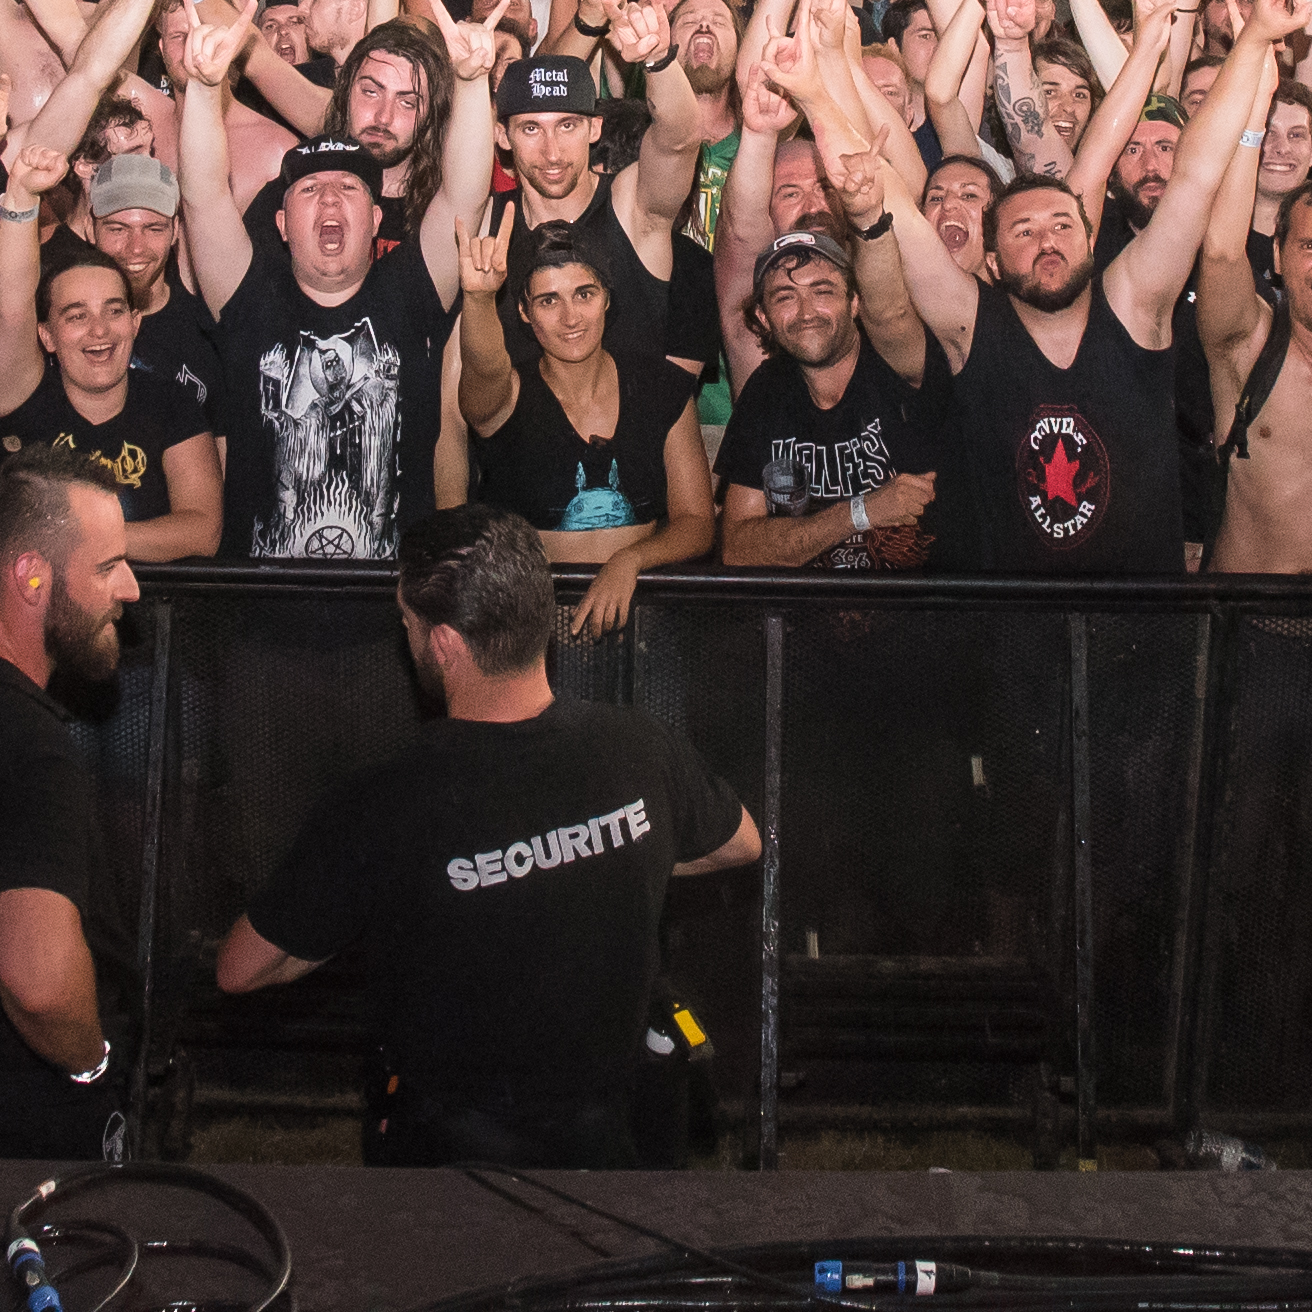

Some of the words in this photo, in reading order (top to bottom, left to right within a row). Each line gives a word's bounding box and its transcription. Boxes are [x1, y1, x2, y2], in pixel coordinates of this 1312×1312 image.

[529, 68, 568, 83] Metal
[531, 83, 568, 98] Head
[447, 798, 651, 891] SECURITE
